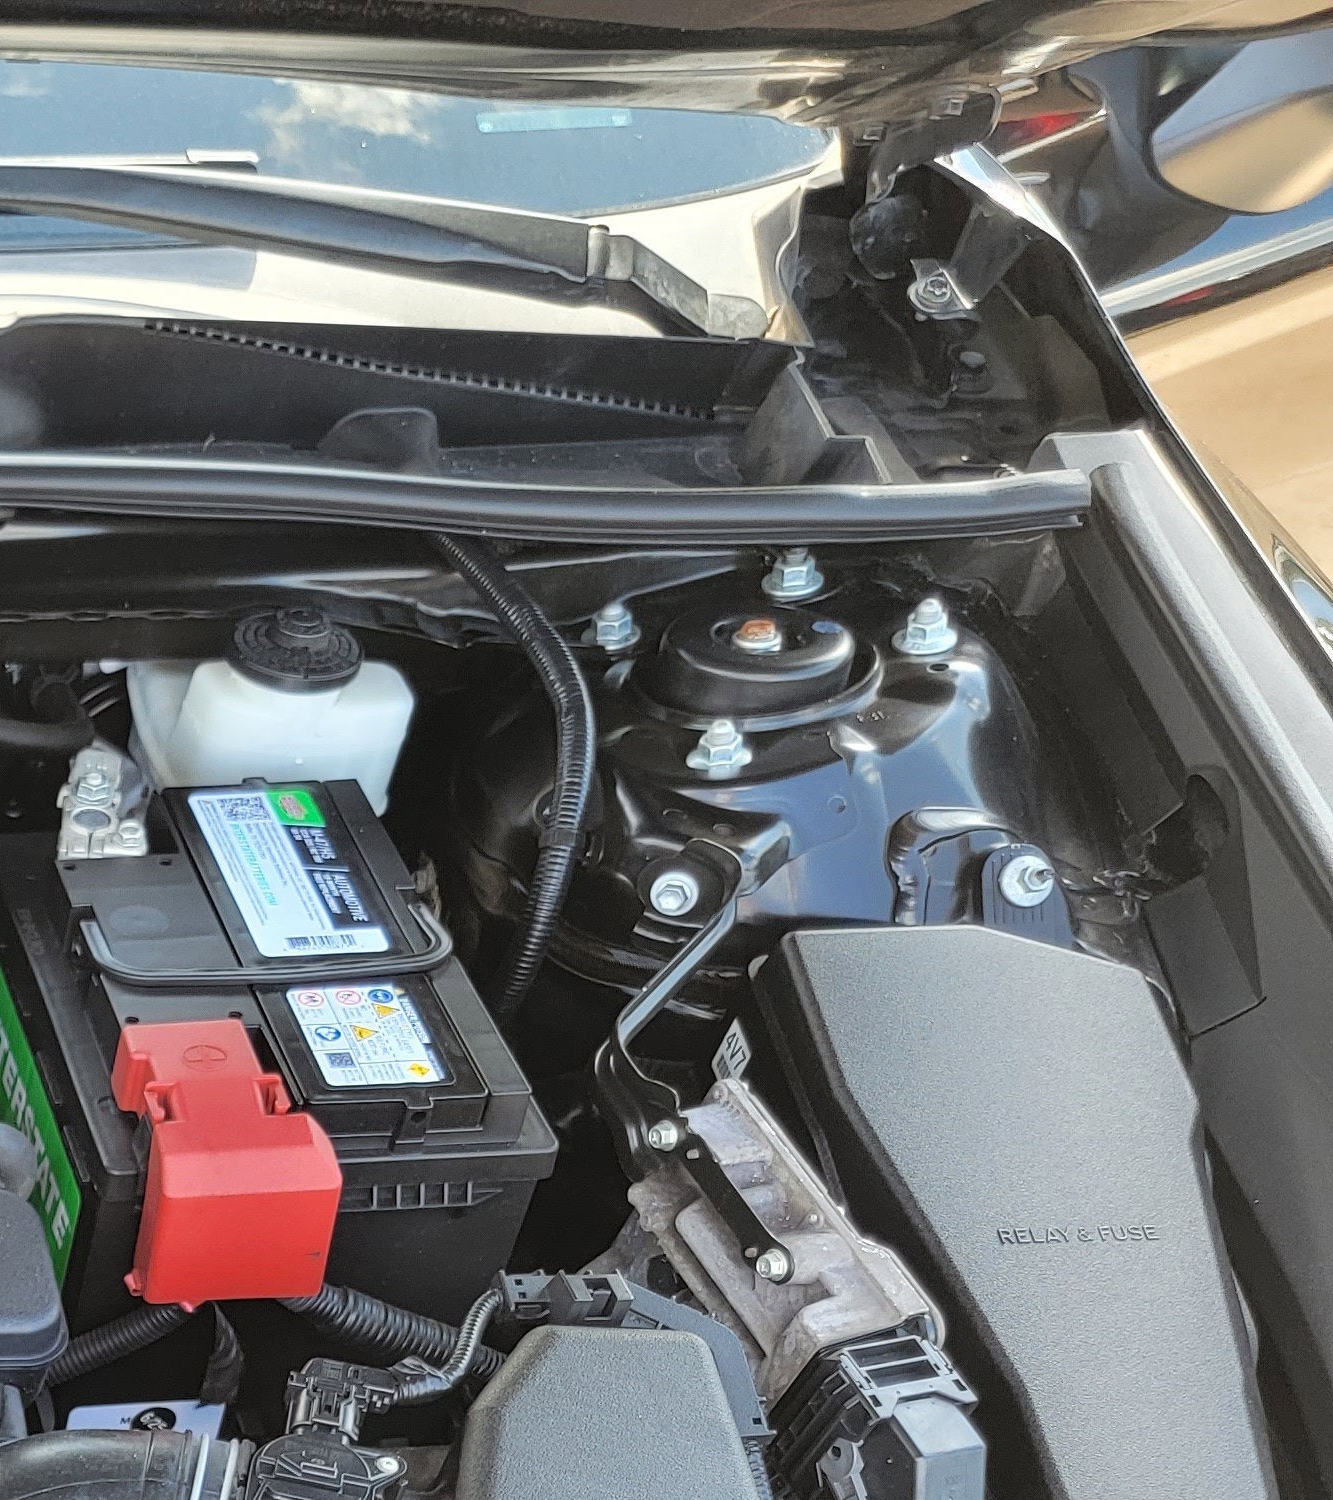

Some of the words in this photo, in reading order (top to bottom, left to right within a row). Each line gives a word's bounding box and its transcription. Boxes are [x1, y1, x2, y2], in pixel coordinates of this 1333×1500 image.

[332, 873, 369, 922] AUTOMOTIVE
[725, 1031, 747, 1071] 4V7
[997, 1226, 1070, 1245] RELAY
[1077, 1226, 1092, 1242] &
[1098, 1224, 1160, 1242] FUSE
